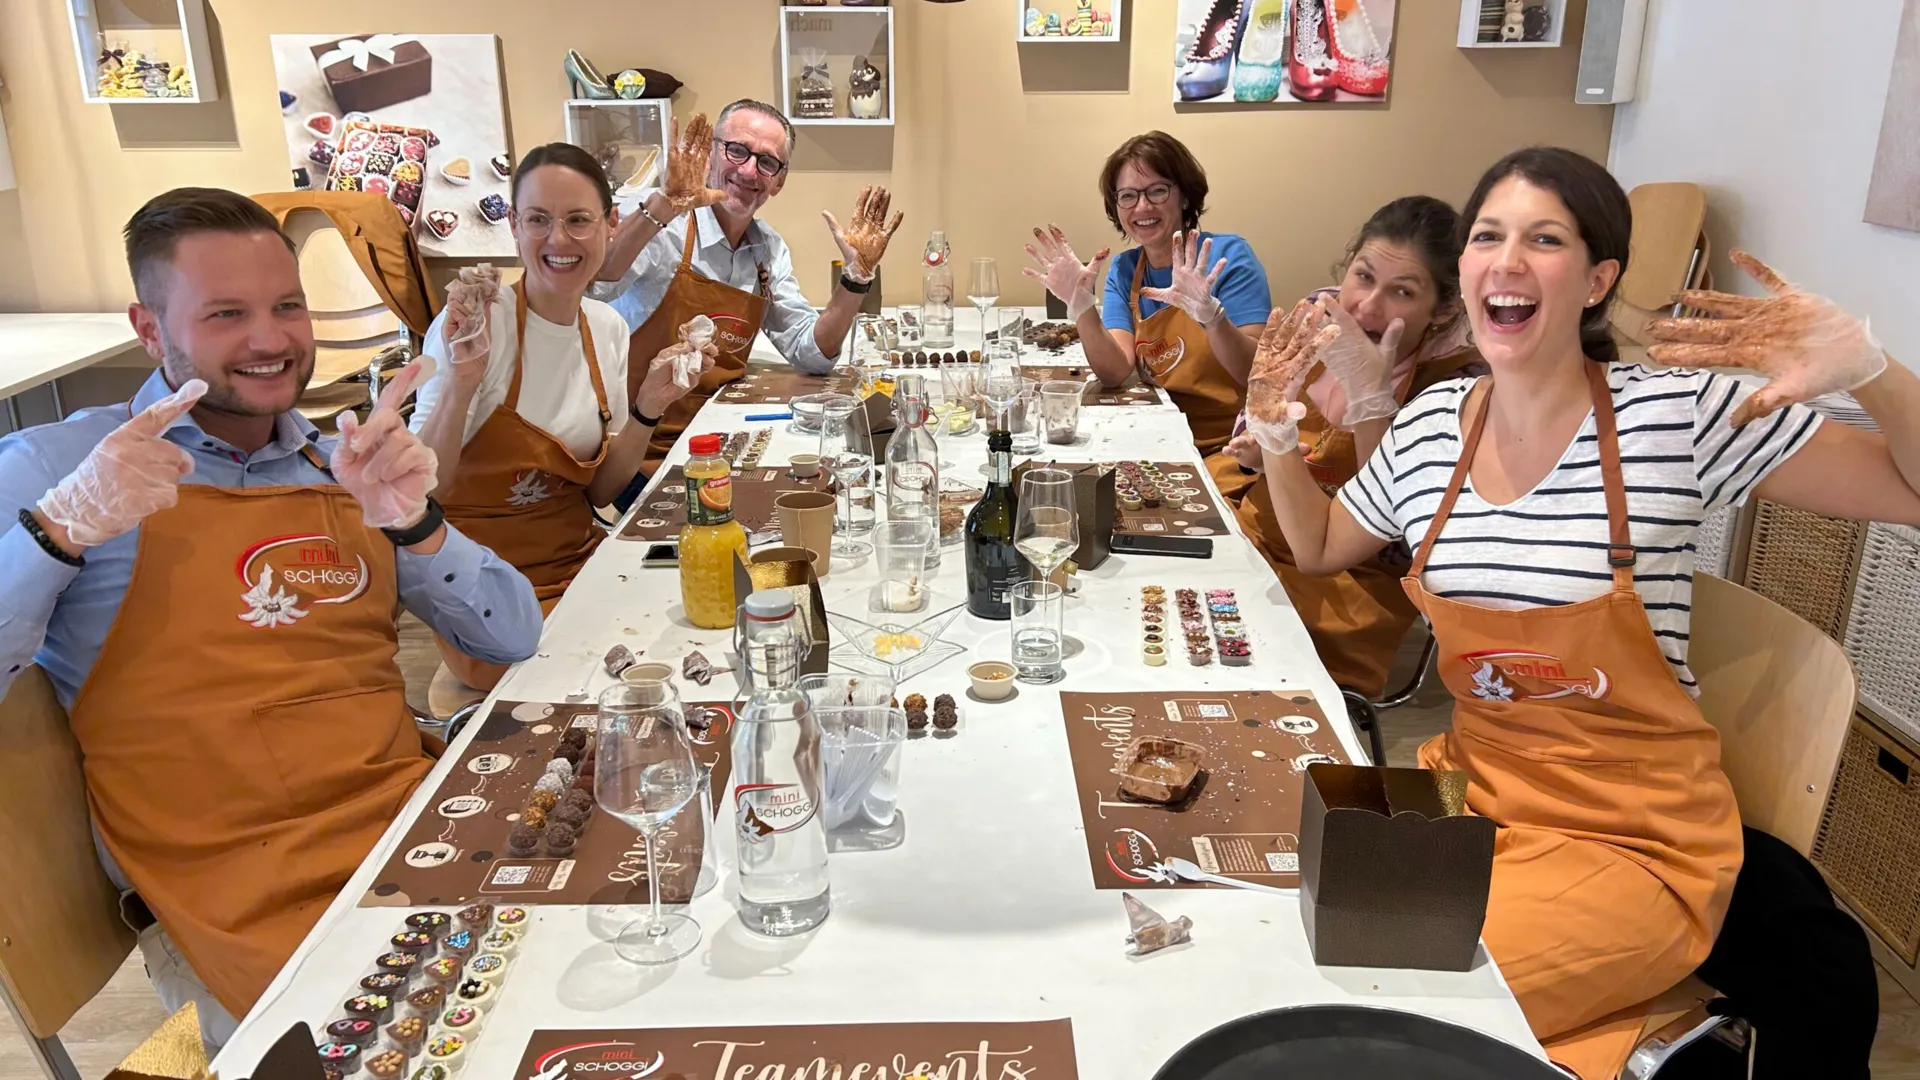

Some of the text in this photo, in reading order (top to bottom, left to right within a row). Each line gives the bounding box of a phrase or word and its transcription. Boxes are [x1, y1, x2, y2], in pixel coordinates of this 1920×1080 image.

[284, 567, 359, 585] SCHOGGI
[1511, 661, 1566, 678] mini
[770, 789, 800, 804] mini
[602, 1048, 636, 1060] mini
[573, 1061, 649, 1072] SCHOGGI
